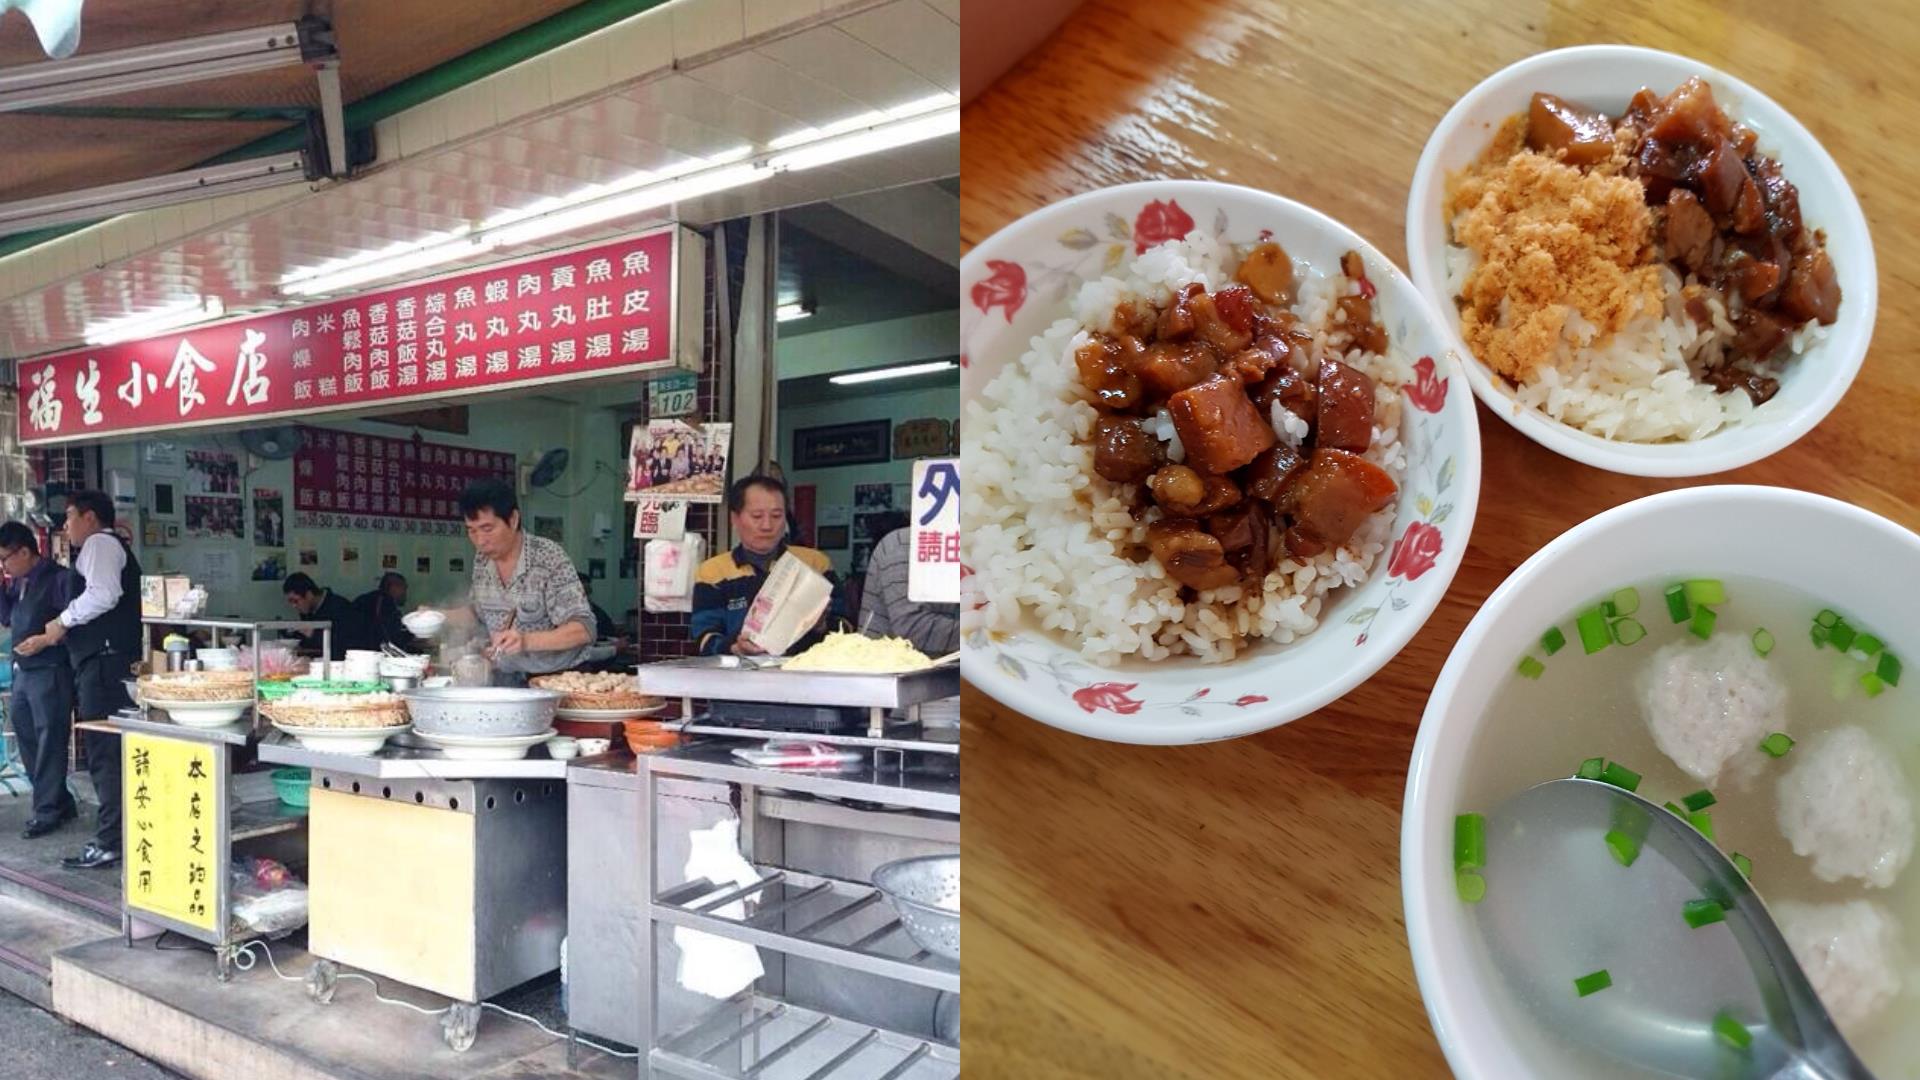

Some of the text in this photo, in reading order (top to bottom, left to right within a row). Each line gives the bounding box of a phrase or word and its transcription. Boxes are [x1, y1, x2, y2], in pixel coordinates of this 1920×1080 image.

[368, 302, 390, 390] 香菇肉飯
[395, 296, 418, 387] 香菇飯湯
[424, 292, 448, 383] 綜合丸湯
[454, 286, 478, 379] 魚丸湯
[484, 278, 510, 374] 蝦丸湯
[517, 273, 542, 369] 肉丸湯
[550, 265, 577, 365] 貢丸湯
[585, 258, 613, 360] 魚肚湯
[621, 250, 651, 354] 魚皮湯
[28, 328, 271, 432] 福生小食店
[292, 318, 312, 400] 肉燥飯
[316, 313, 338, 397] 米糕
[342, 308, 363, 393] 魚鬆肉飯
[663, 392, 693, 413] 102
[132, 748, 153, 893] 請安心食用
